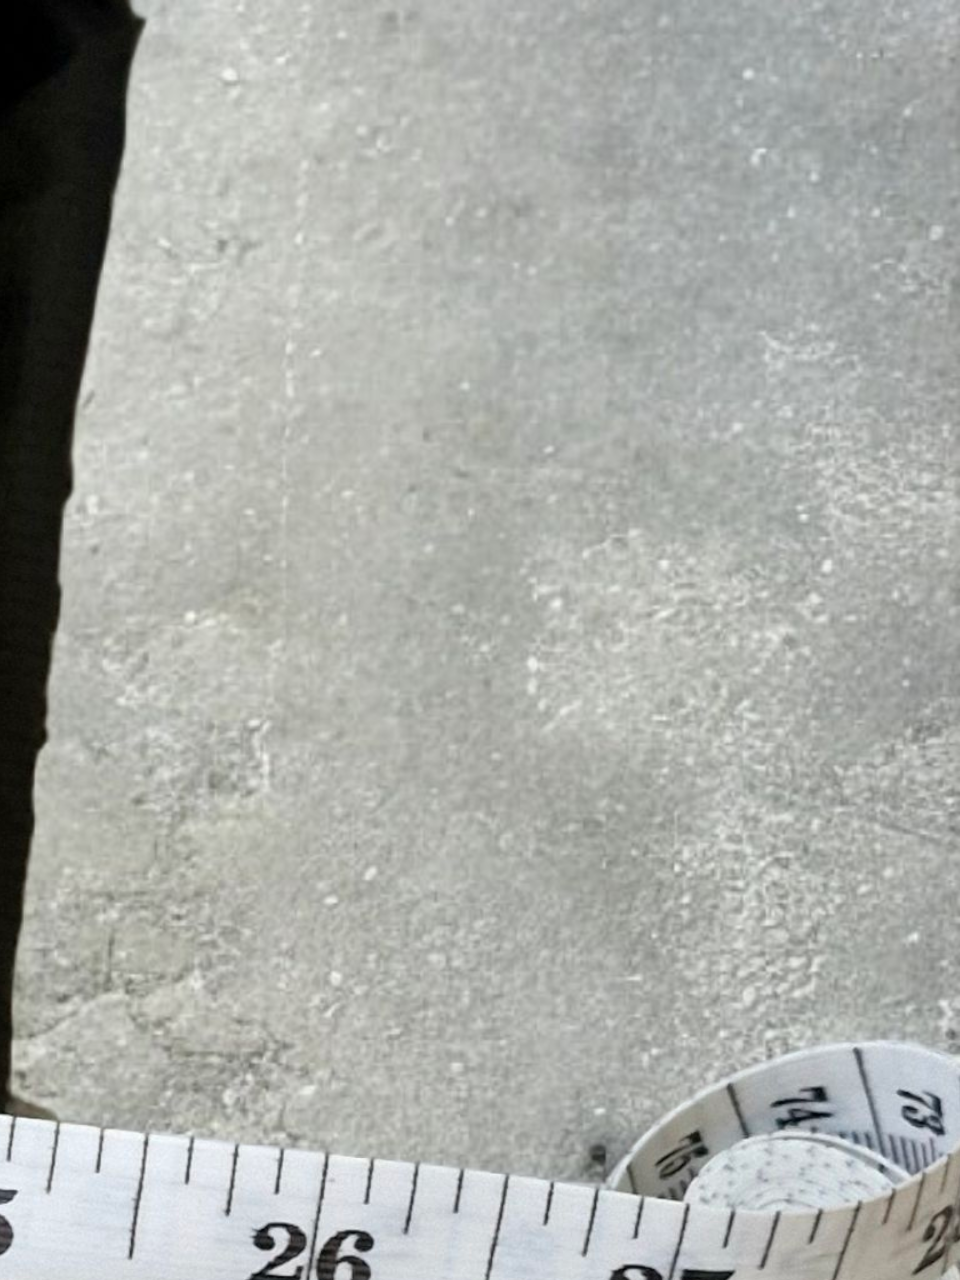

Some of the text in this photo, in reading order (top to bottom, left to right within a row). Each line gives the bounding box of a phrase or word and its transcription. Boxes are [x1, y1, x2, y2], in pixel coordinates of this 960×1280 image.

[770, 1086, 833, 1130] 74
[897, 1088, 946, 1136] 73
[655, 1130, 709, 1179] 75
[911, 1204, 960, 1275] 2
